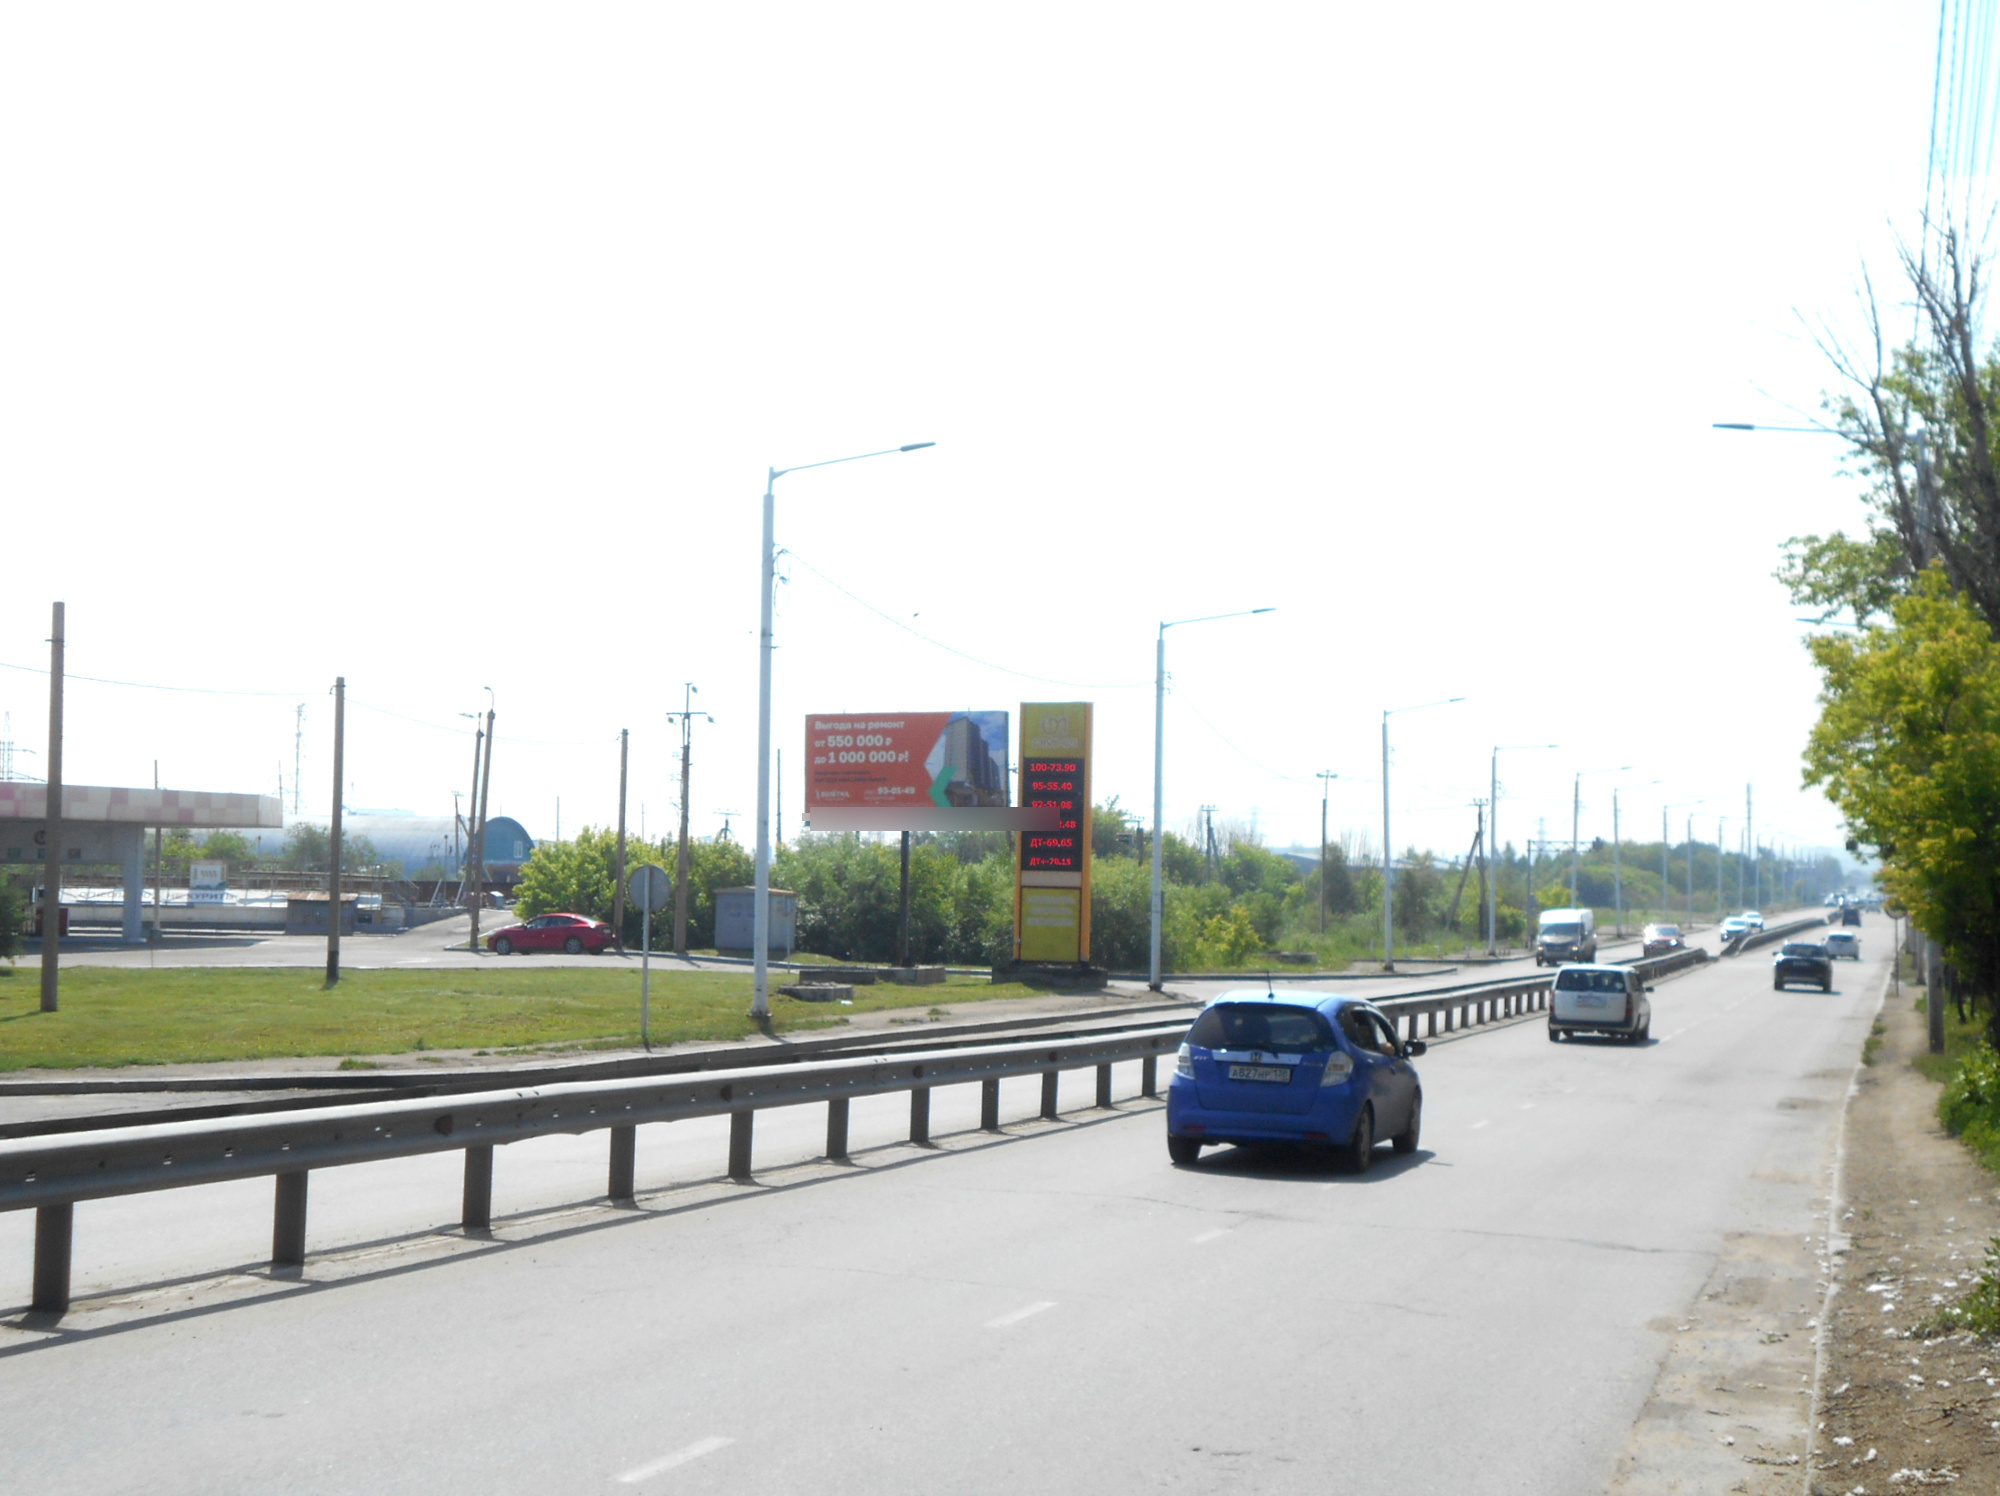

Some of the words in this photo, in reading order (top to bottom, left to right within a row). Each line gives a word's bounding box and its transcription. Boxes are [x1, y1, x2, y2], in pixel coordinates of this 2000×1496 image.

[815, 721, 851, 730] Выгода
[867, 721, 904, 730] ремонт
[827, 735, 853, 747] 550
[856, 735, 883, 747] 000
[814, 756, 826, 764] до
[828, 752, 836, 763] 1
[839, 751, 866, 763] 000
[869, 751, 896, 763] 000
[1030, 763, 1076, 772] 100-73.90
[1032, 782, 1073, 791] 95-55.40
[1030, 838, 1073, 848] ДТ-69.65
